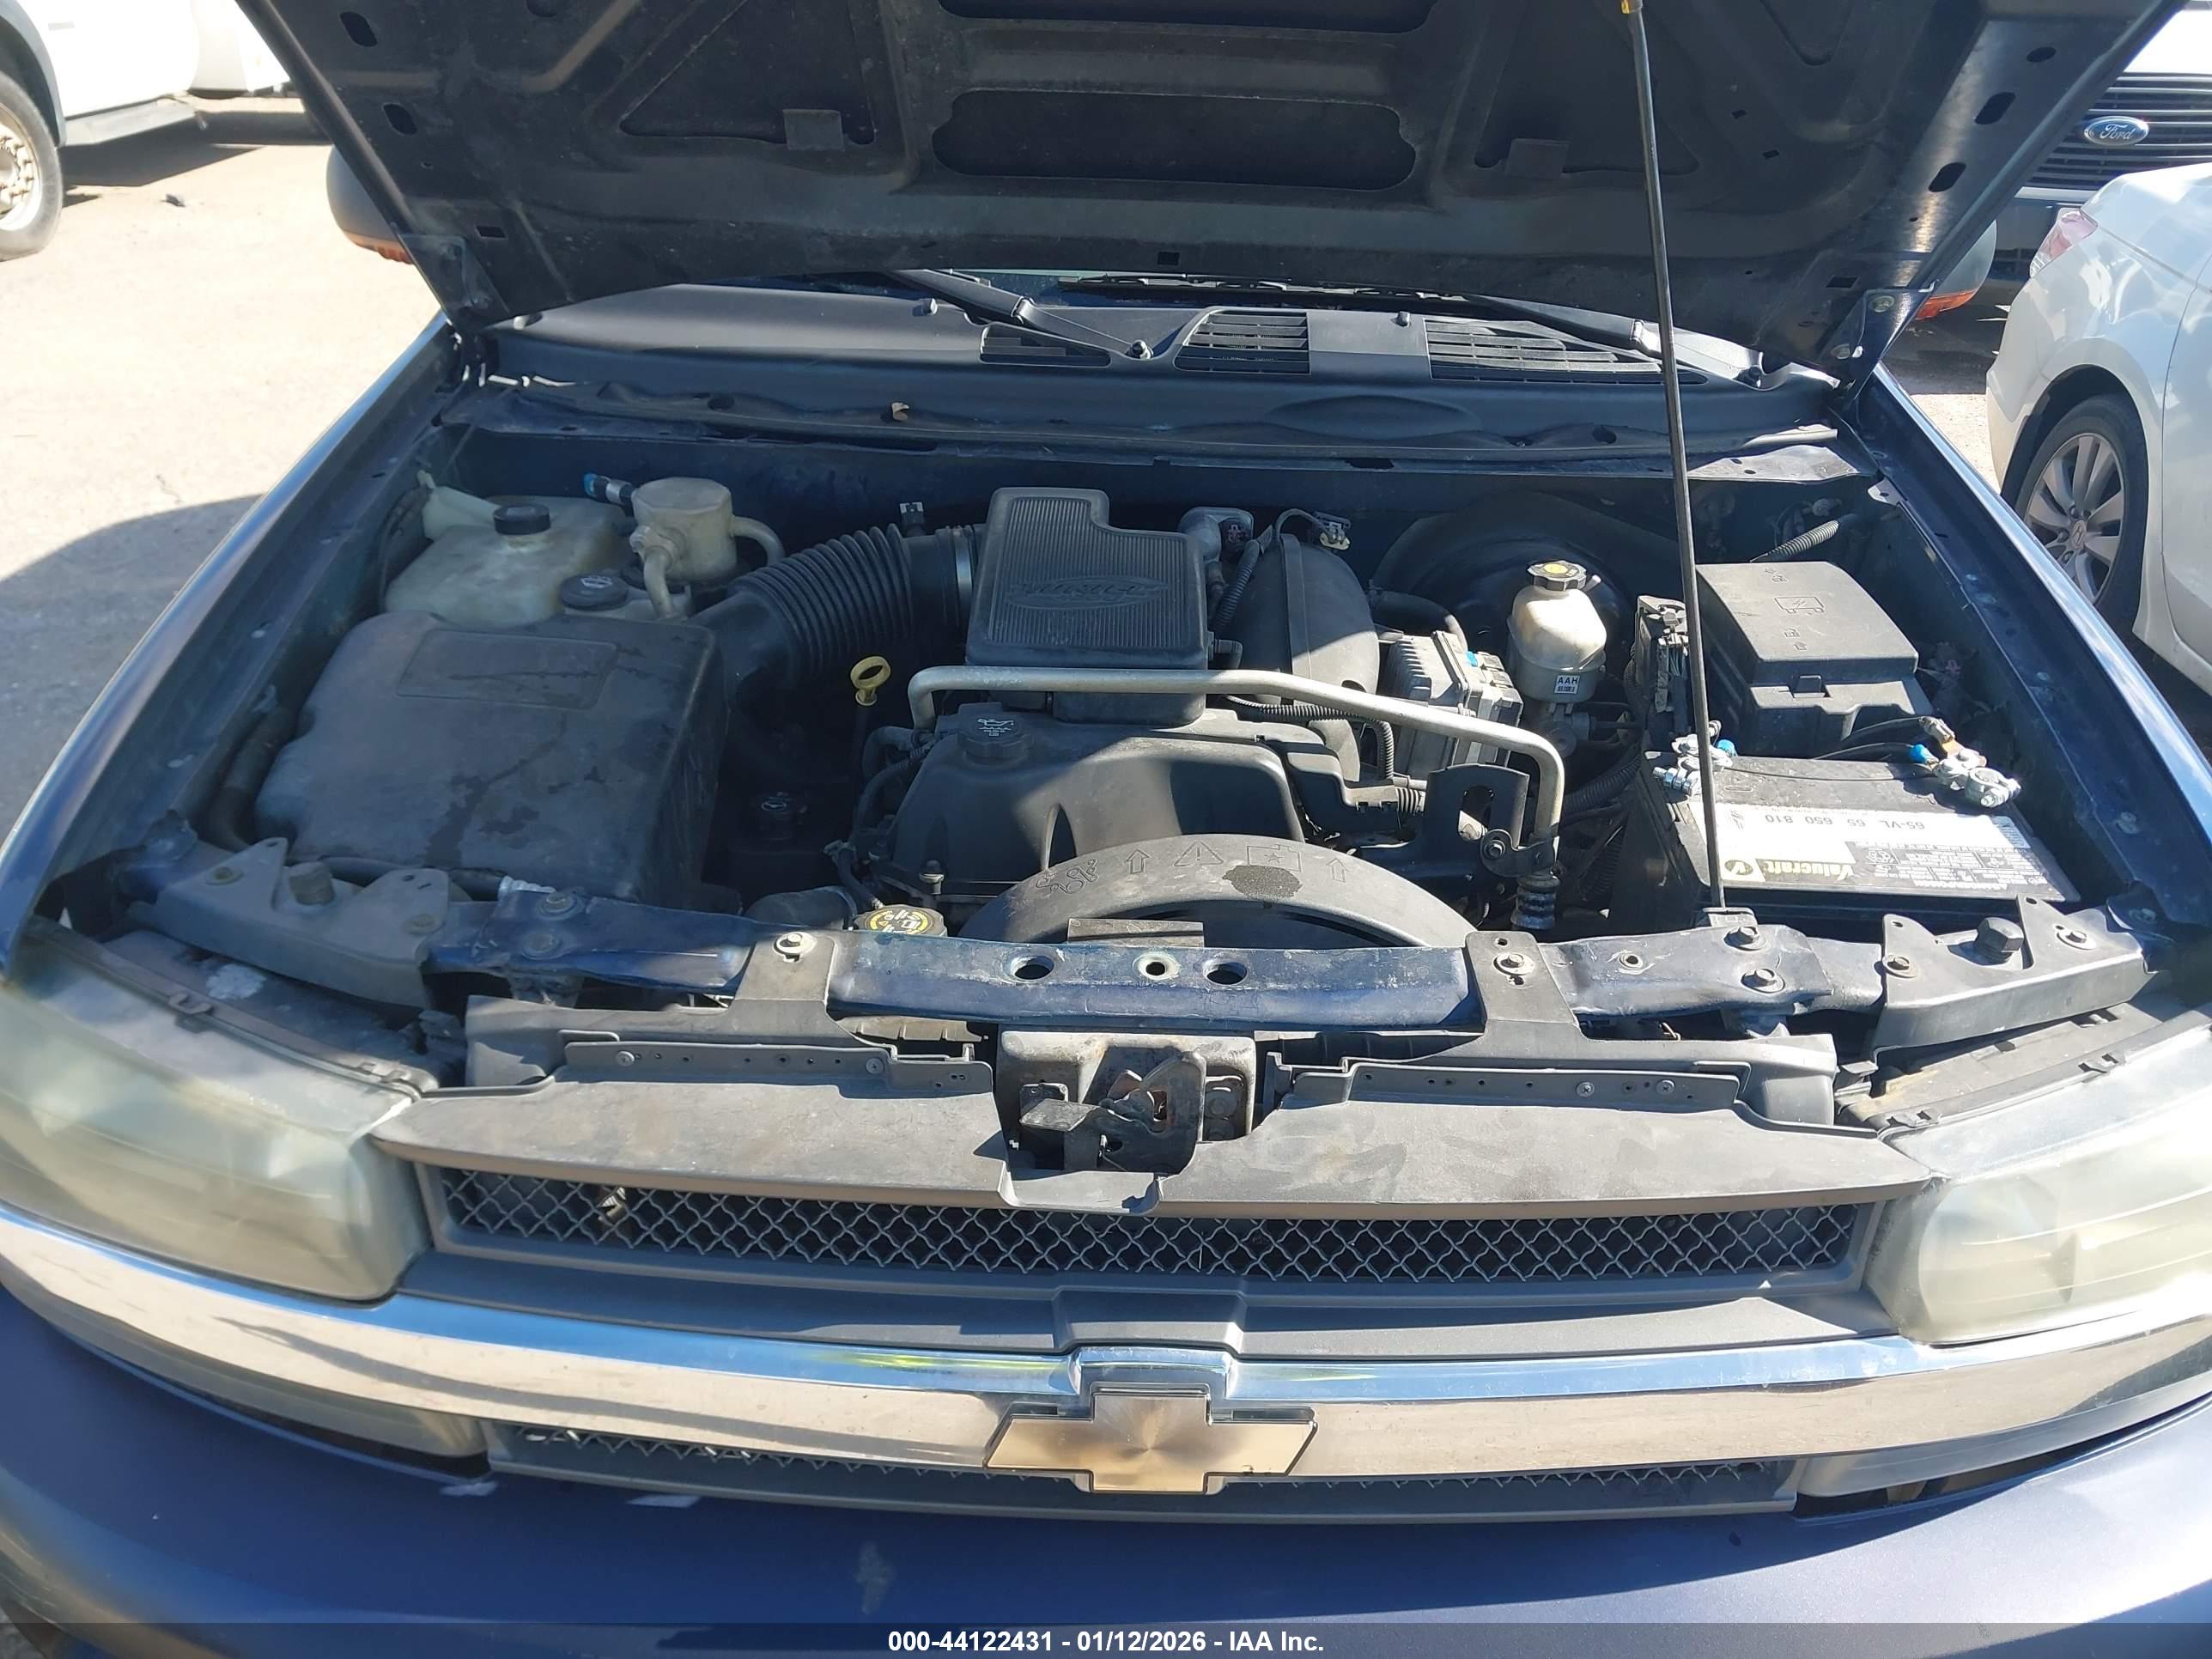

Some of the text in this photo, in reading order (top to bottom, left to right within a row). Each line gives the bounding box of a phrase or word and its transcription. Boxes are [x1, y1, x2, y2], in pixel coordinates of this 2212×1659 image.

[2100, 124, 2136, 140] Ford
[1765, 814, 1925, 830] 65-VL 65 650 810
[1764, 860, 1855, 880] Valucraft
